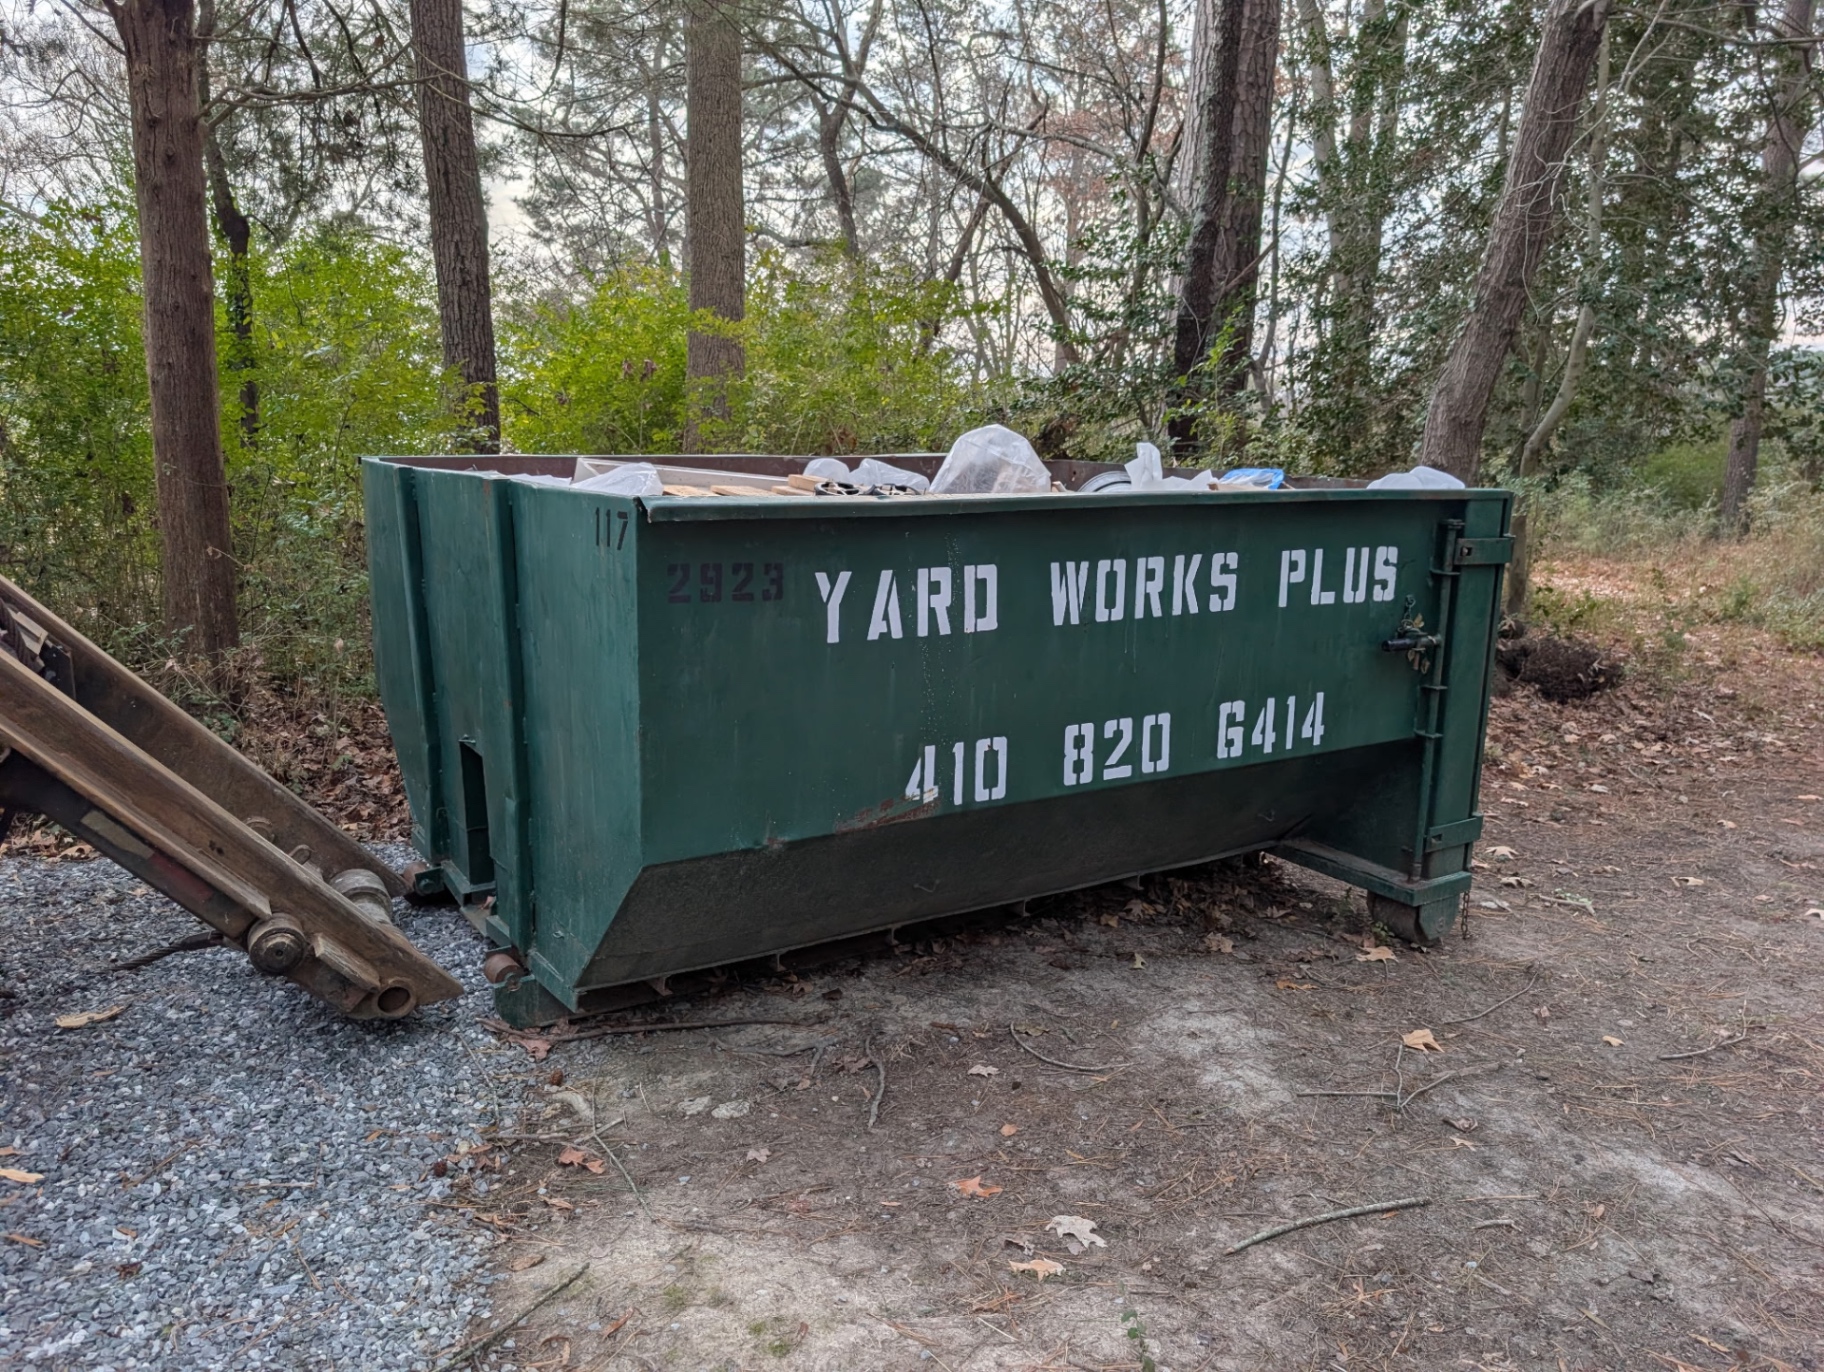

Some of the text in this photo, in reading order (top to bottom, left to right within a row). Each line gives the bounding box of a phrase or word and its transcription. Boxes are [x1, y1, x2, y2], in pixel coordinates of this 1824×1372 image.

[594, 506, 628, 551] 117
[667, 562, 784, 604] 2923
[814, 545, 1399, 644] YARD WORKS PLUS
[904, 691, 1326, 806] 410 820 6414
